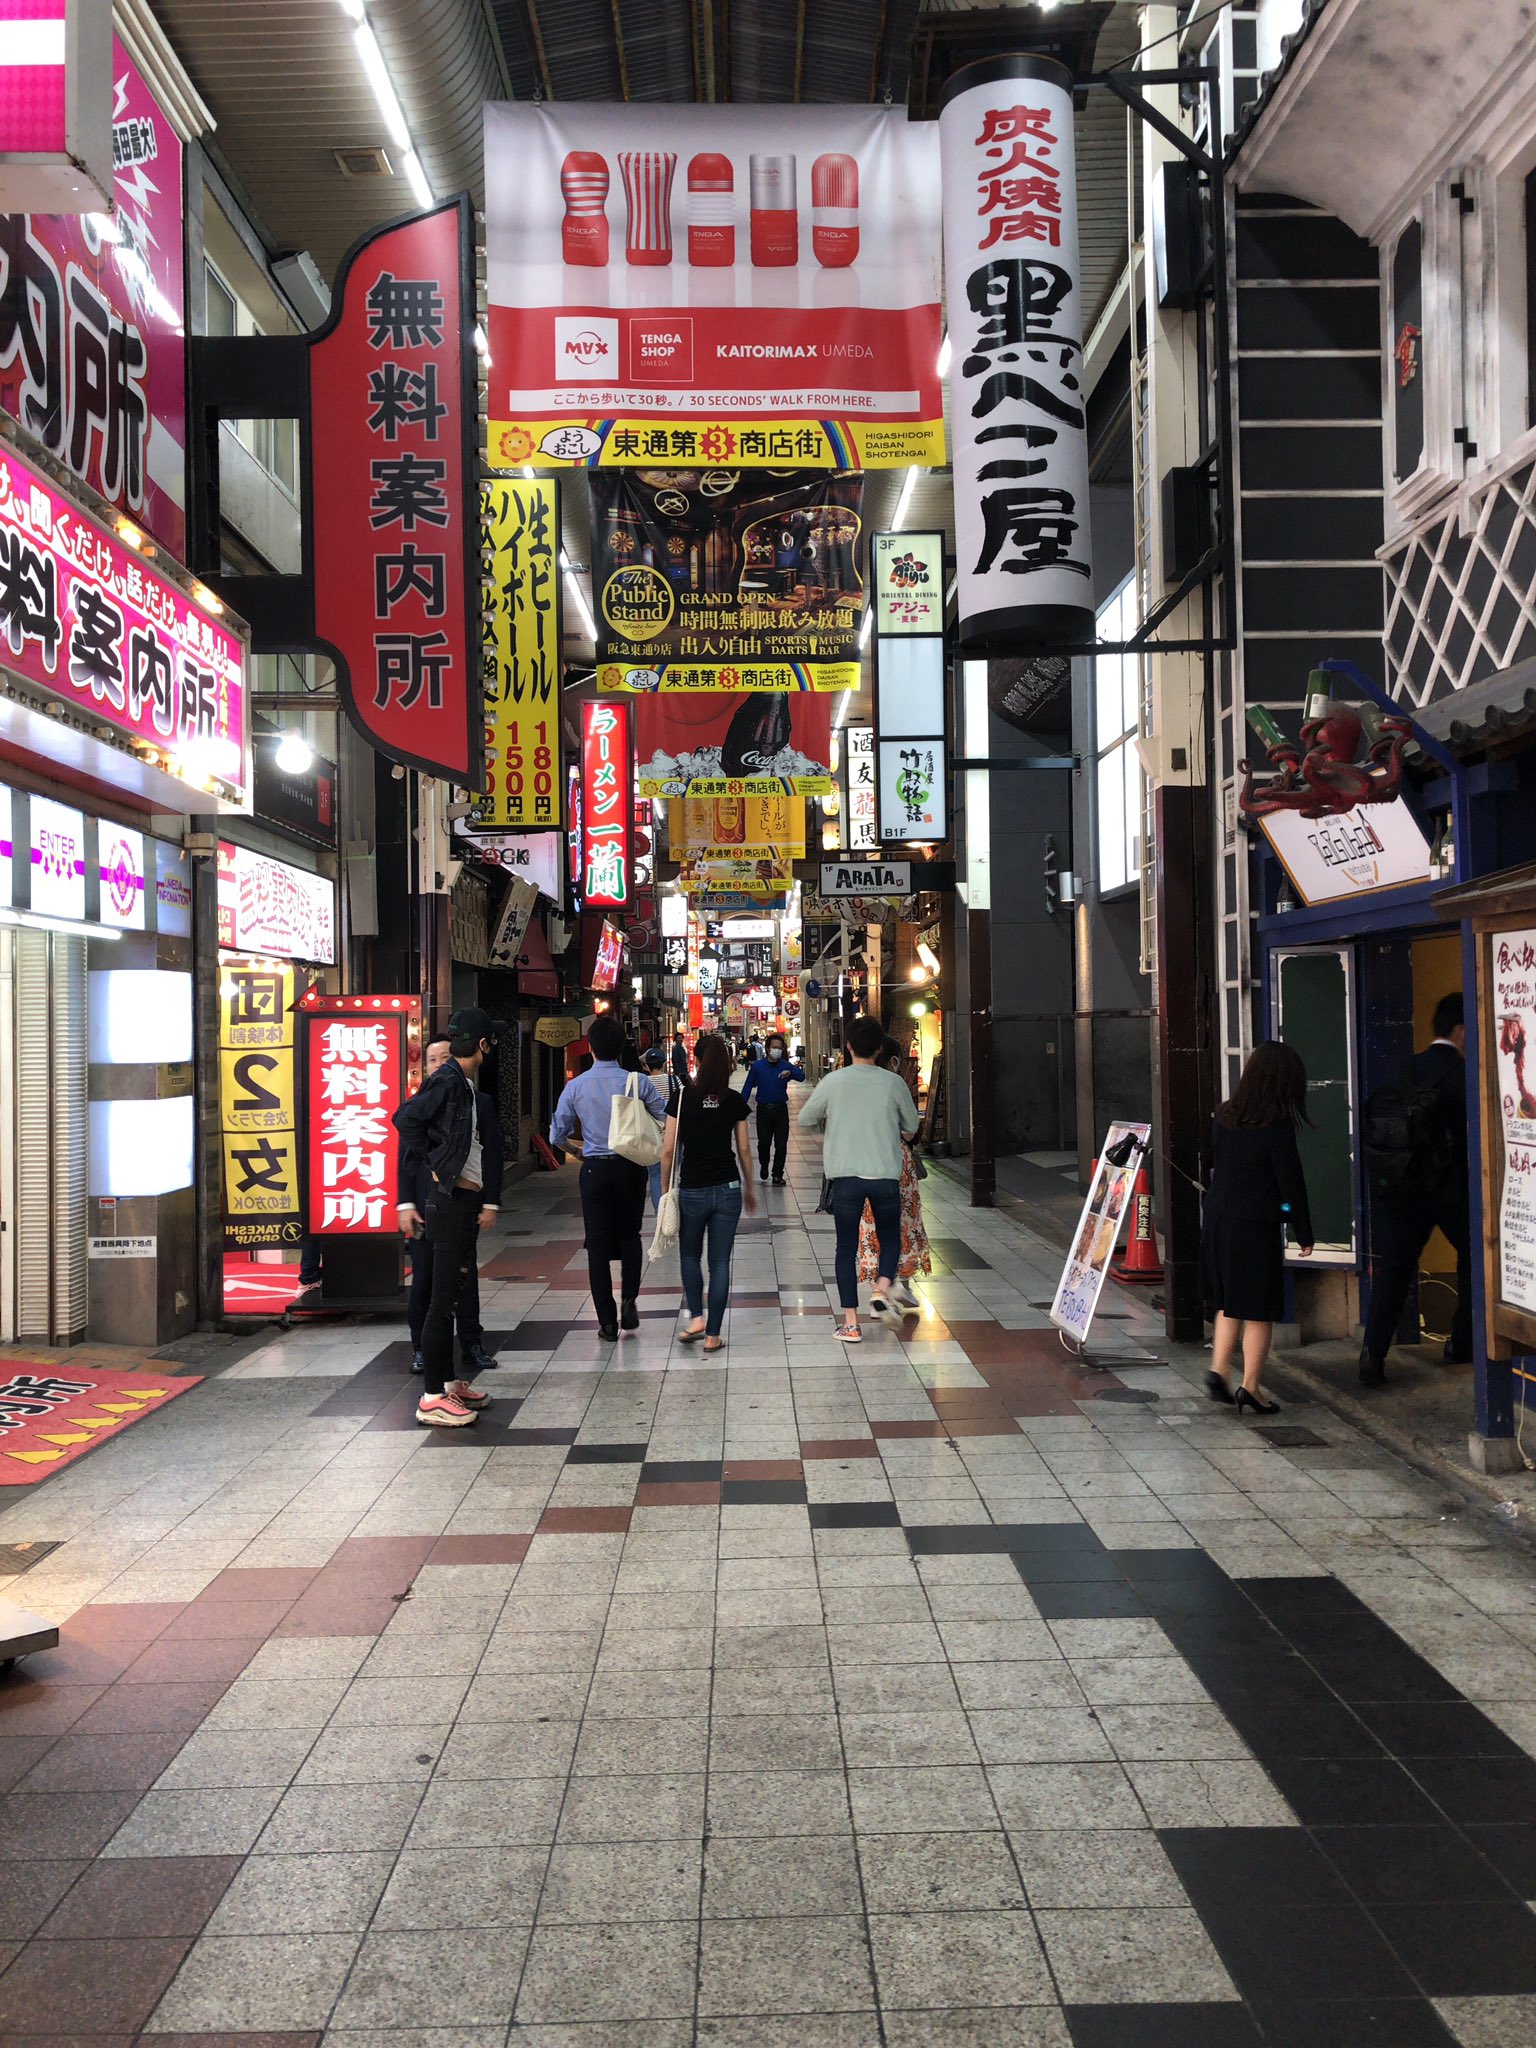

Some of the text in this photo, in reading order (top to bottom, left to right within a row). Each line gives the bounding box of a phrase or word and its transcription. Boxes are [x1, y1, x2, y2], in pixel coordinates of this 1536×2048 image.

[975, 104, 1062, 250] 炭火焼肉
[566, 226, 600, 235] TENGA
[817, 230, 848, 238] TENGA
[640, 333, 682, 345] TENGA
[640, 346, 675, 358] SHOP
[716, 344, 874, 359] KAITORIMAX UMEDA
[690, 395, 705, 406] 30
[770, 394, 804, 405] WALK
[807, 394, 840, 405] FROM
[843, 395, 876, 407] HERE.
[559, 430, 584, 443] よう
[865, 430, 934, 441] HIGASHIDORI
[553, 442, 591, 456] おこし
[865, 441, 904, 449] DAISAN
[865, 450, 927, 459] SHOTENGAI
[366, 271, 452, 709] 無料案内所
[880, 540, 896, 549] 3F
[622, 571, 651, 584] The
[499, 489, 526, 704] ハイボール
[528, 488, 553, 704] 生ビール
[610, 584, 669, 603] Public
[680, 592, 776, 605] GRAND OPEN
[680, 609, 855, 631] 時間無制限飲み放題
[680, 635, 762, 656] 出入り自由
[765, 635, 854, 645] SPORTS MUSIC
[607, 642, 673, 656] 阪急東通り店
[771, 646, 840, 655] DARTS BAR
[925, 751, 934, 784] 居酒屋
[900, 748, 924, 822] 竹取物語
[885, 828, 907, 837] B1F
[40, 829, 76, 857] ENTER
[321, 1023, 388, 1230] 無料案内所
